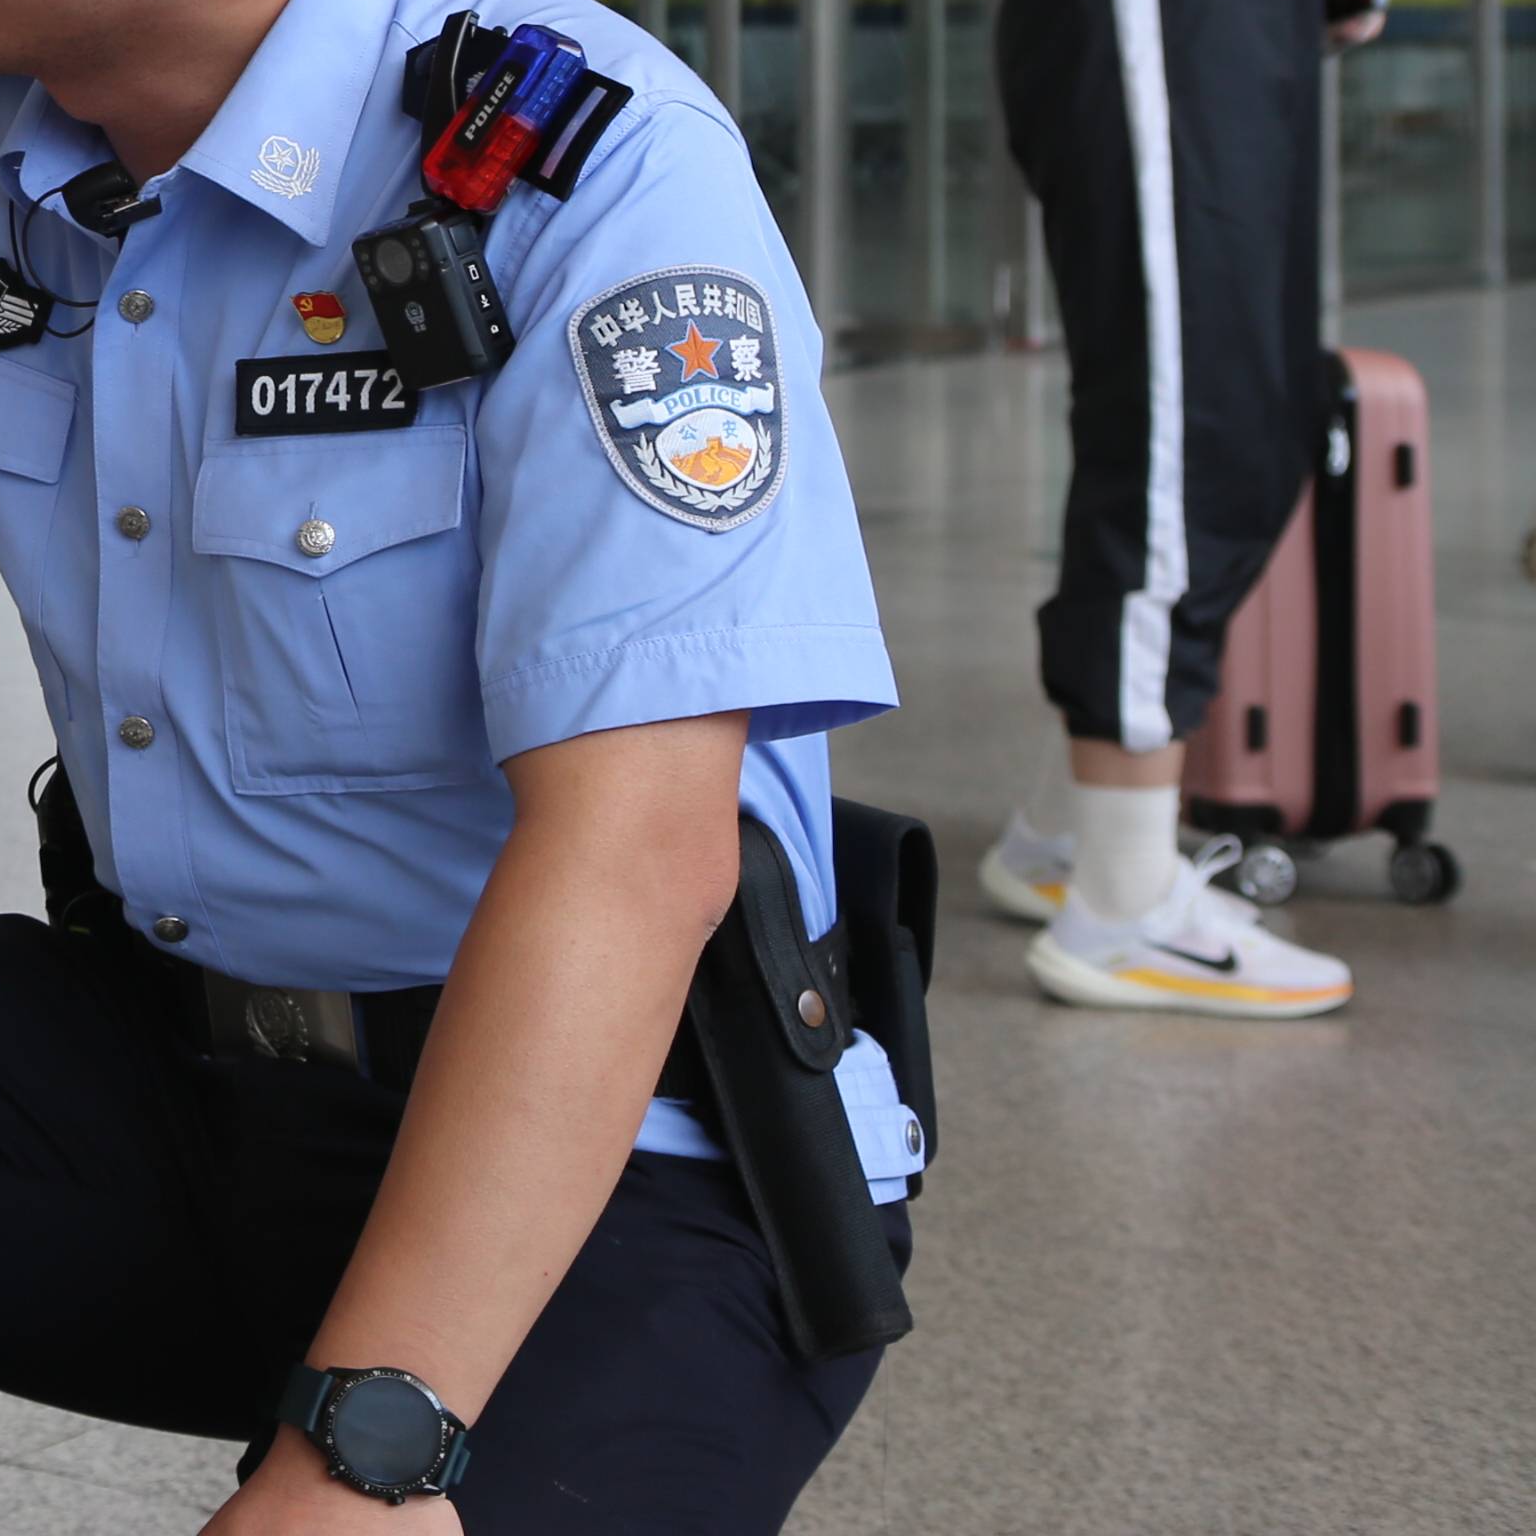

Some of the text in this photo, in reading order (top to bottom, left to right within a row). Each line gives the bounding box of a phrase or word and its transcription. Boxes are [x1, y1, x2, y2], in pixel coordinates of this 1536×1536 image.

[464, 71, 516, 141] POLICE
[590, 283, 764, 348] 中华人民共和国
[251, 368, 406, 416] 017472
[663, 385, 742, 416] POLICE
